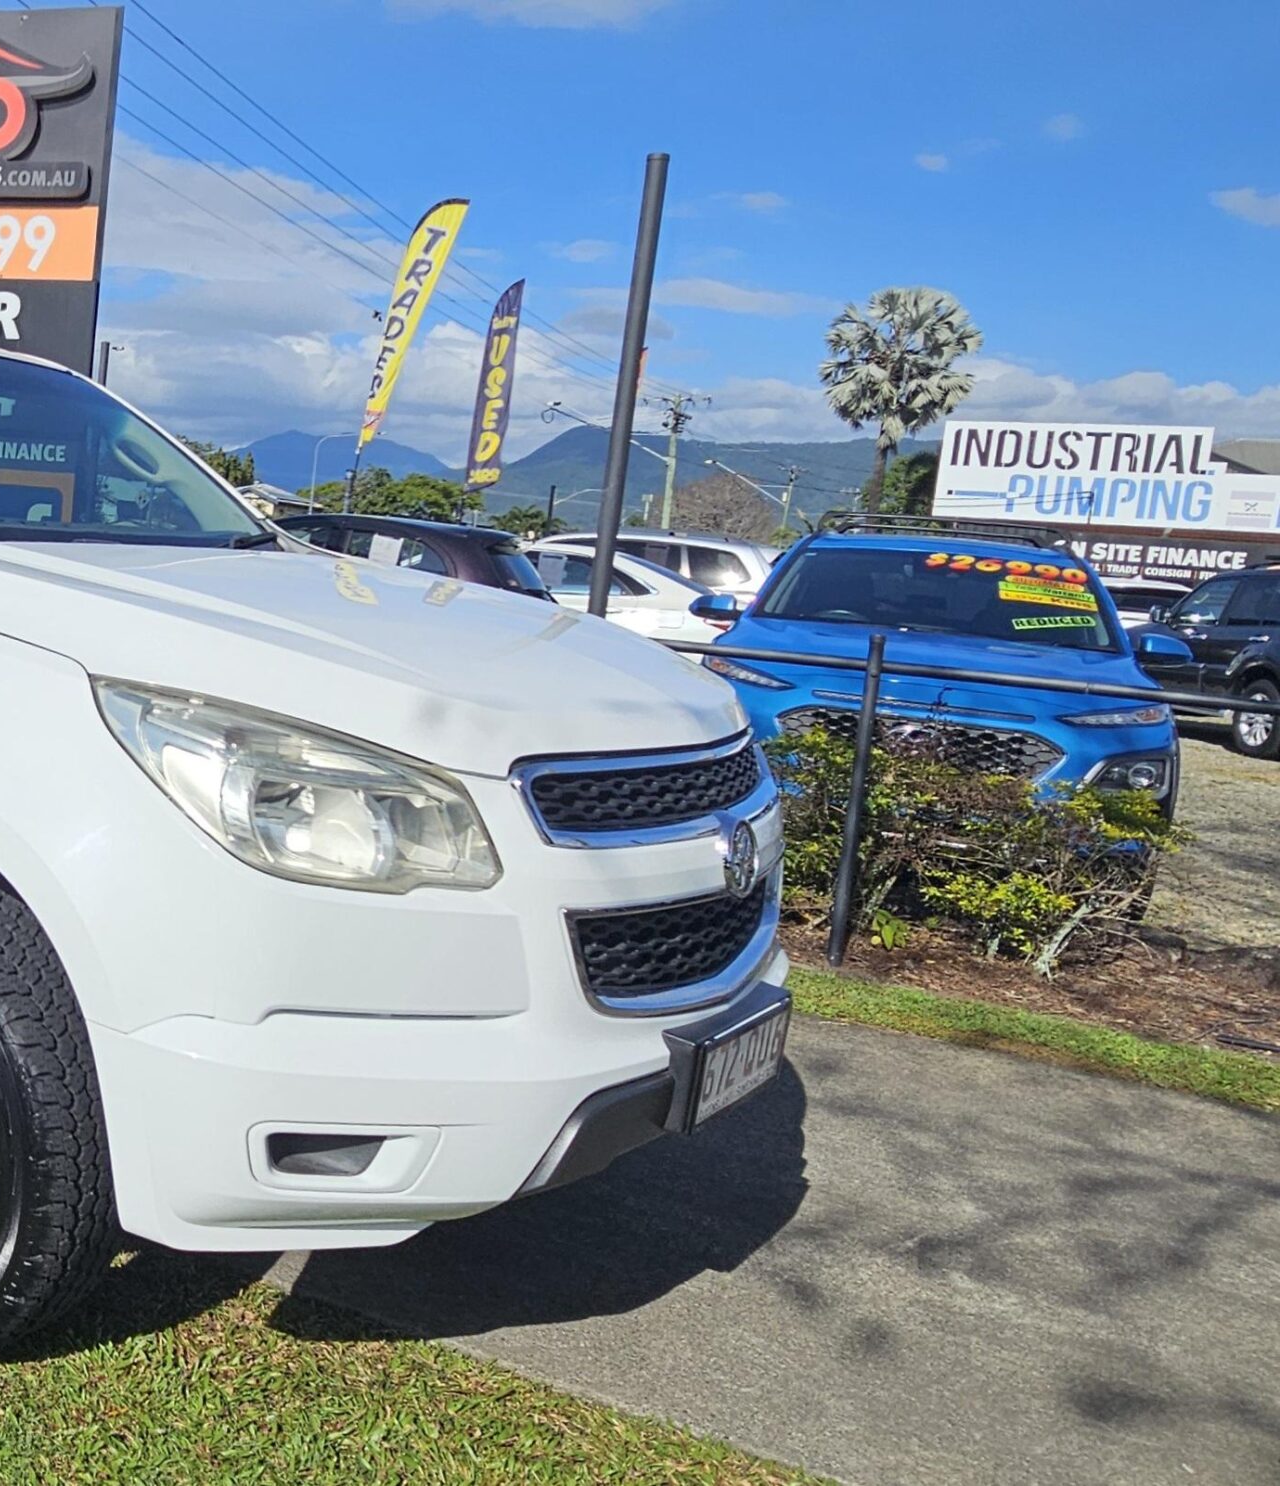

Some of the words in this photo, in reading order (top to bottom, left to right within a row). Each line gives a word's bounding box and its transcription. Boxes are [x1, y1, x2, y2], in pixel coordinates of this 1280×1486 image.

[474, 334, 510, 463] USED
[949, 428, 1215, 475] INDUSTRIAL
[1005, 473, 1214, 523] PUMPING
[924, 553, 1088, 584] $26990
[1090, 542, 1143, 562] SITE
[1146, 546, 1248, 570] FINANCE
[1107, 563, 1139, 575] TRADE
[1144, 567, 1192, 579] CONSIGN
[1014, 617, 1091, 628] REDUCED
